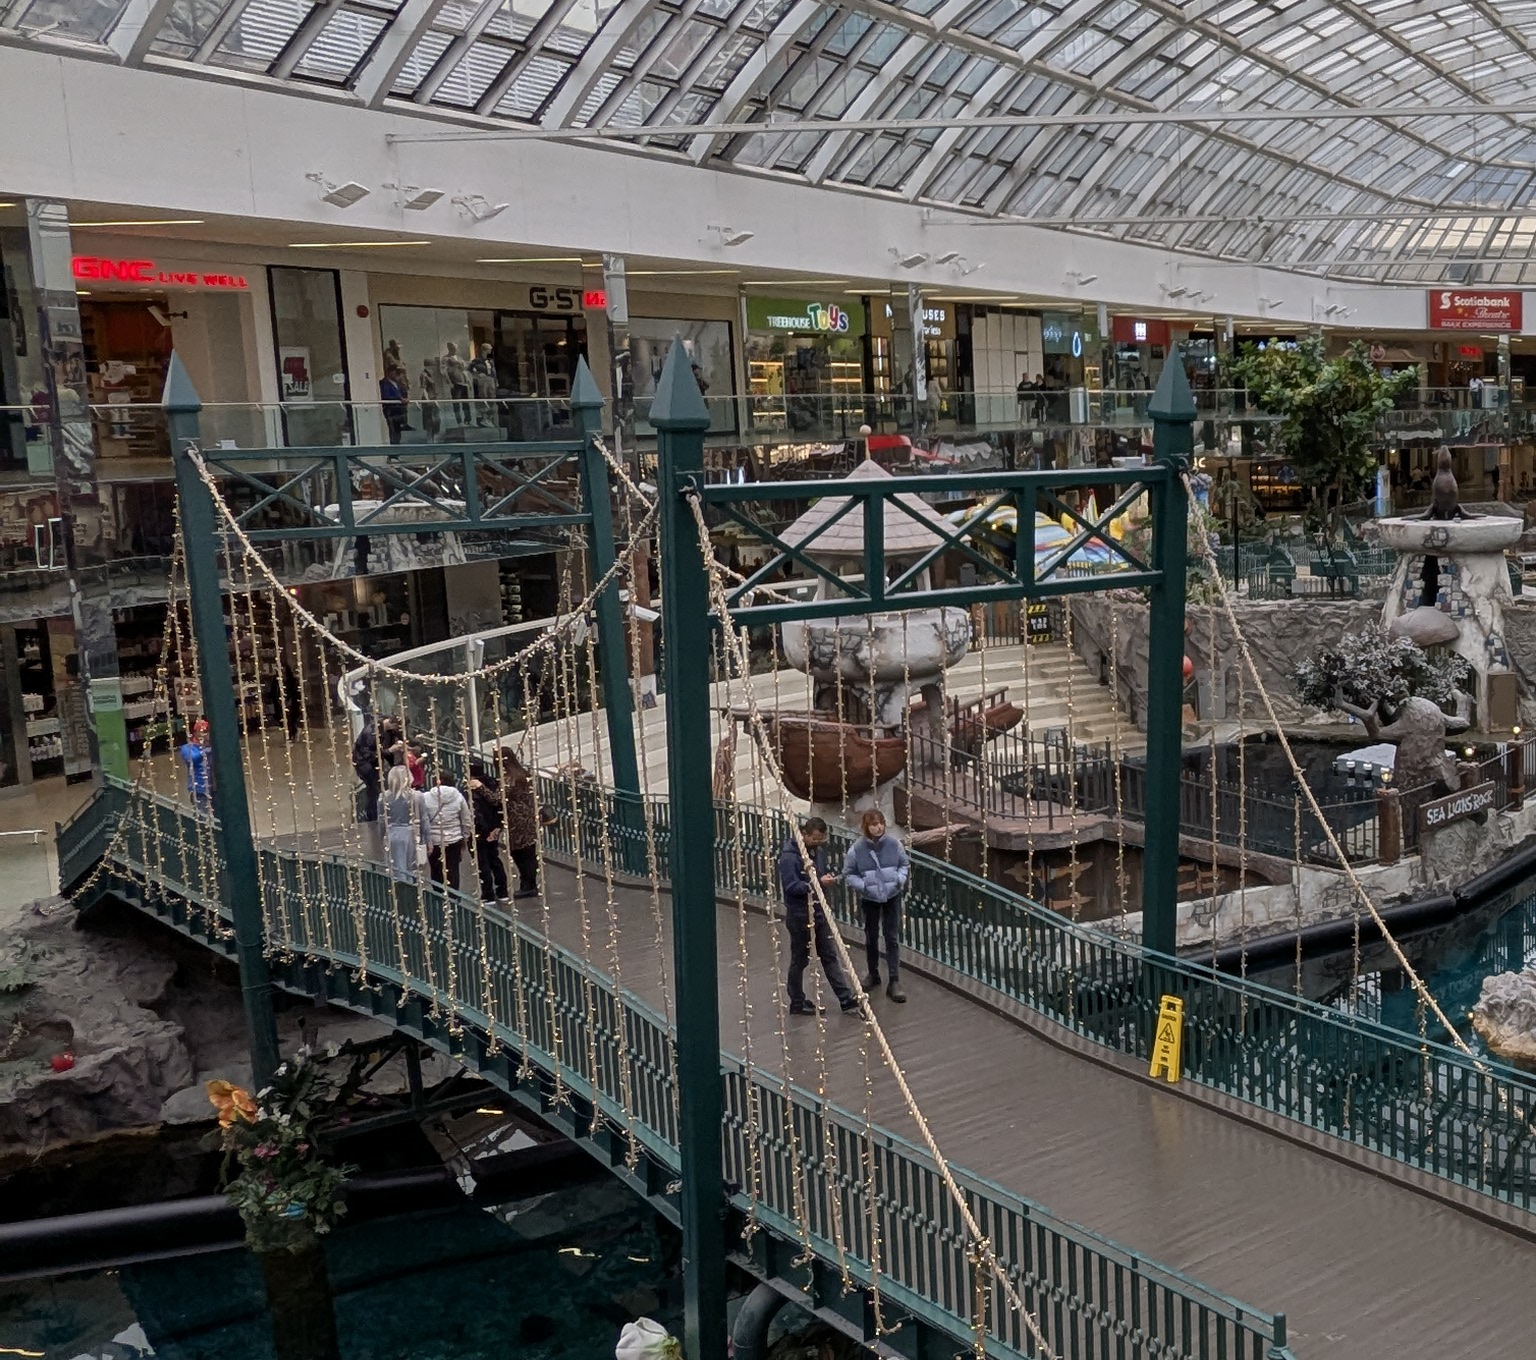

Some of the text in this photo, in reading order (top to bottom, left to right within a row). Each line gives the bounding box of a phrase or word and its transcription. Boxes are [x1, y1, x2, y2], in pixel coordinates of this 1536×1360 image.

[72, 257, 248, 288] GNC LIVE WELL
[1454, 295, 1511, 307] Scotiabank
[767, 316, 811, 329] TREEHOUSE
[1427, 806, 1446, 825] SEA
[1473, 789, 1494, 811] ROCK
